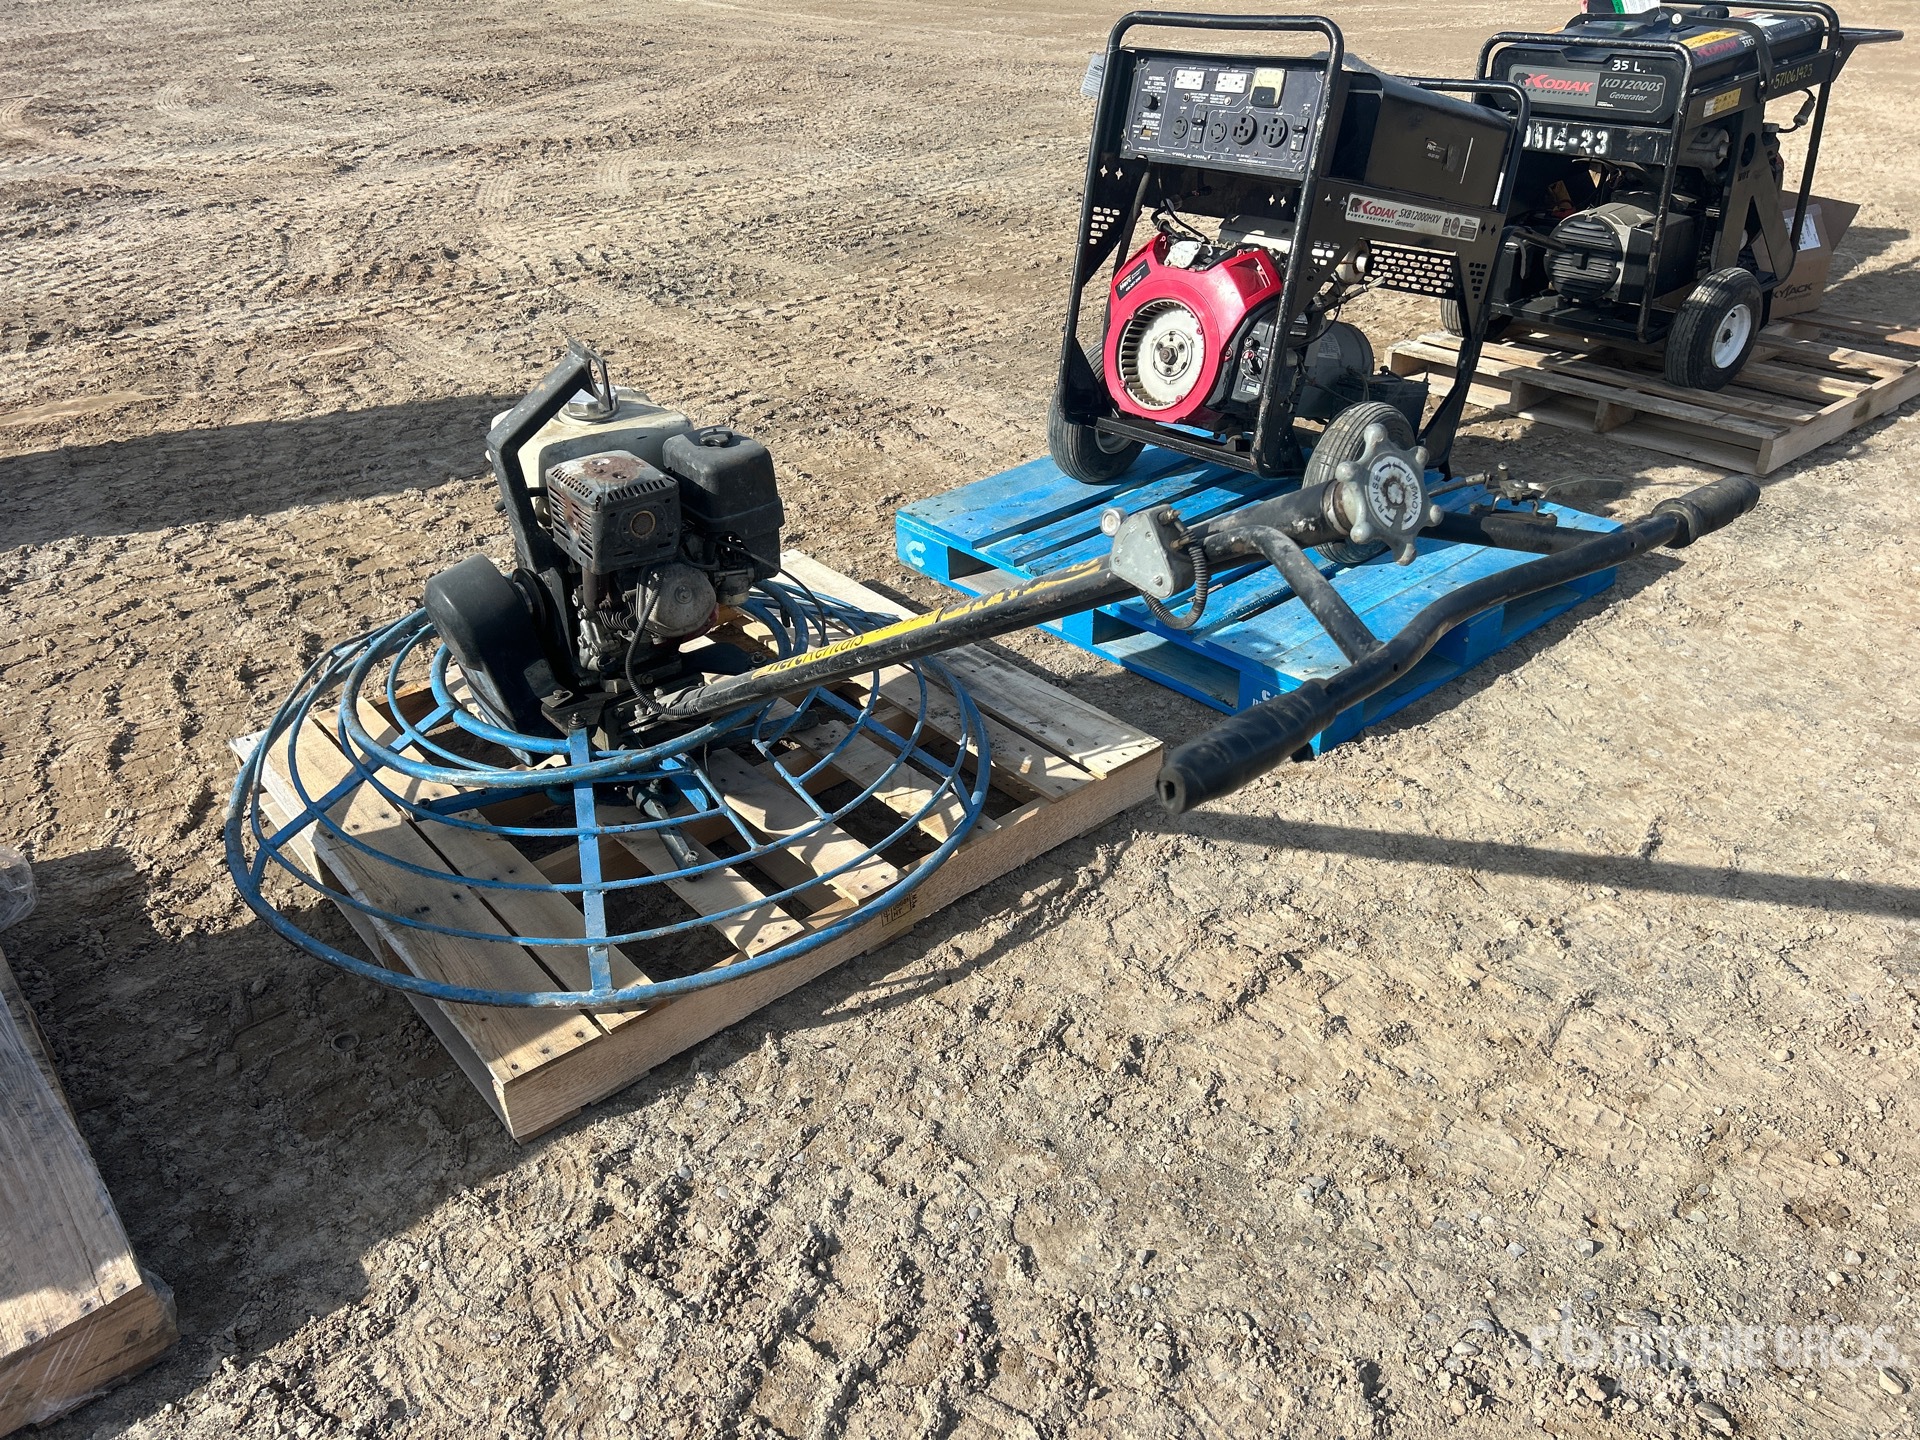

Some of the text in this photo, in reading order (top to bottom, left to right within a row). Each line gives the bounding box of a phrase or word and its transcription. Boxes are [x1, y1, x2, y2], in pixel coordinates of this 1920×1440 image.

[1611, 59, 1630, 72] 35
[1526, 73, 1595, 93] KODIAK
[1601, 78, 1664, 92] KD12000S
[1541, 89, 1590, 97] EQUIPMENT
[1609, 91, 1648, 102] Generator
[1358, 200, 1398, 220] KODIAK
[1398, 208, 1442, 225] SXB12000HXV
[1395, 219, 1416, 229] Generator
[1372, 474, 1385, 514] RAISE
[1405, 473, 1420, 516] LOWER
